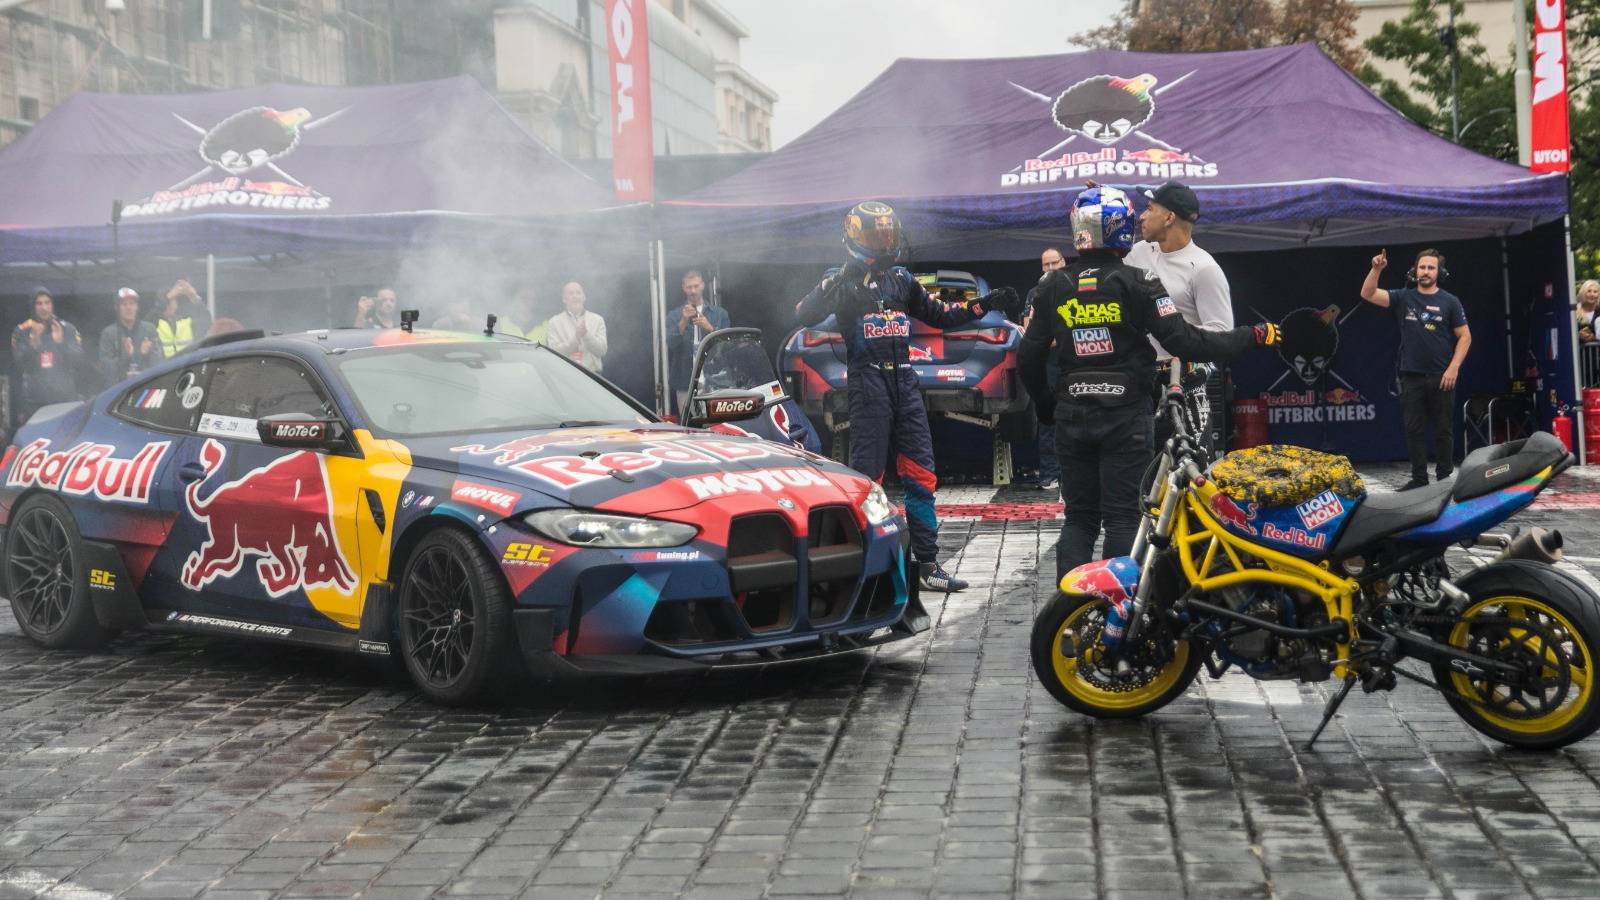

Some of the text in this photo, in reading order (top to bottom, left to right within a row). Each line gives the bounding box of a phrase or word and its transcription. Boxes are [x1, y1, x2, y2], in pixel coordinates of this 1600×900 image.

[1025, 147, 1116, 171] Red Bull
[1001, 161, 1218, 187] DRIFTBROTHERS
[120, 190, 332, 216] DRIFTBROTHERS
[1075, 302, 1121, 318] ARAS
[864, 322, 893, 340] Red
[1074, 329, 1109, 342] LIQUI
[1076, 341, 1111, 354] MOLY
[716, 400, 753, 412] MoTeC
[276, 425, 319, 437] MoTeC
[6, 438, 172, 503] Red Bull
[509, 440, 721, 490] Red
[684, 468, 833, 499] MOTUL
[455, 486, 516, 508] MOTUL
[1299, 490, 1336, 516] LIQUI
[1304, 502, 1341, 528] MOLY
[1262, 522, 1326, 549] Red Bull
[656, 551, 699, 560] tuning.pl
[188, 615, 257, 631] PERFORMANCE
[256, 624, 293, 636] PARTS
